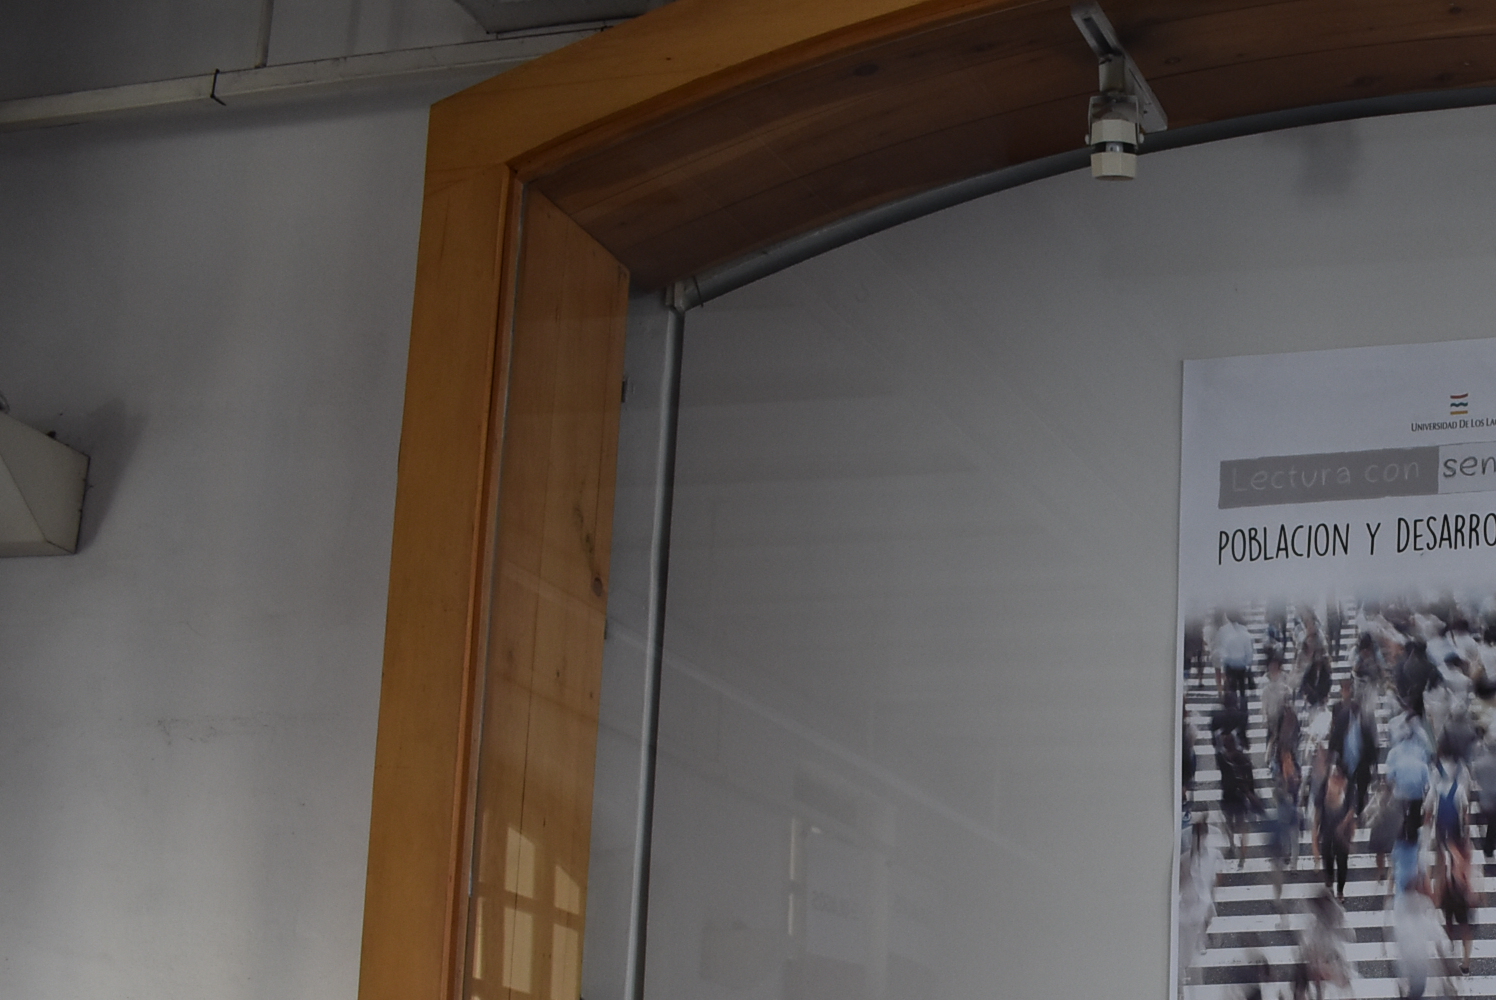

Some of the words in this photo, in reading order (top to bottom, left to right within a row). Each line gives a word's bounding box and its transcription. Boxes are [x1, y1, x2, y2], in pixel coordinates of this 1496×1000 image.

[1411, 421, 1457, 432] UNIVERSIDAD
[1471, 418, 1484, 428] LOS
[1232, 464, 1351, 492] Lectura
[1364, 461, 1419, 484] con
[1218, 523, 1350, 565] POBLACION
[1366, 522, 1381, 555] Y
